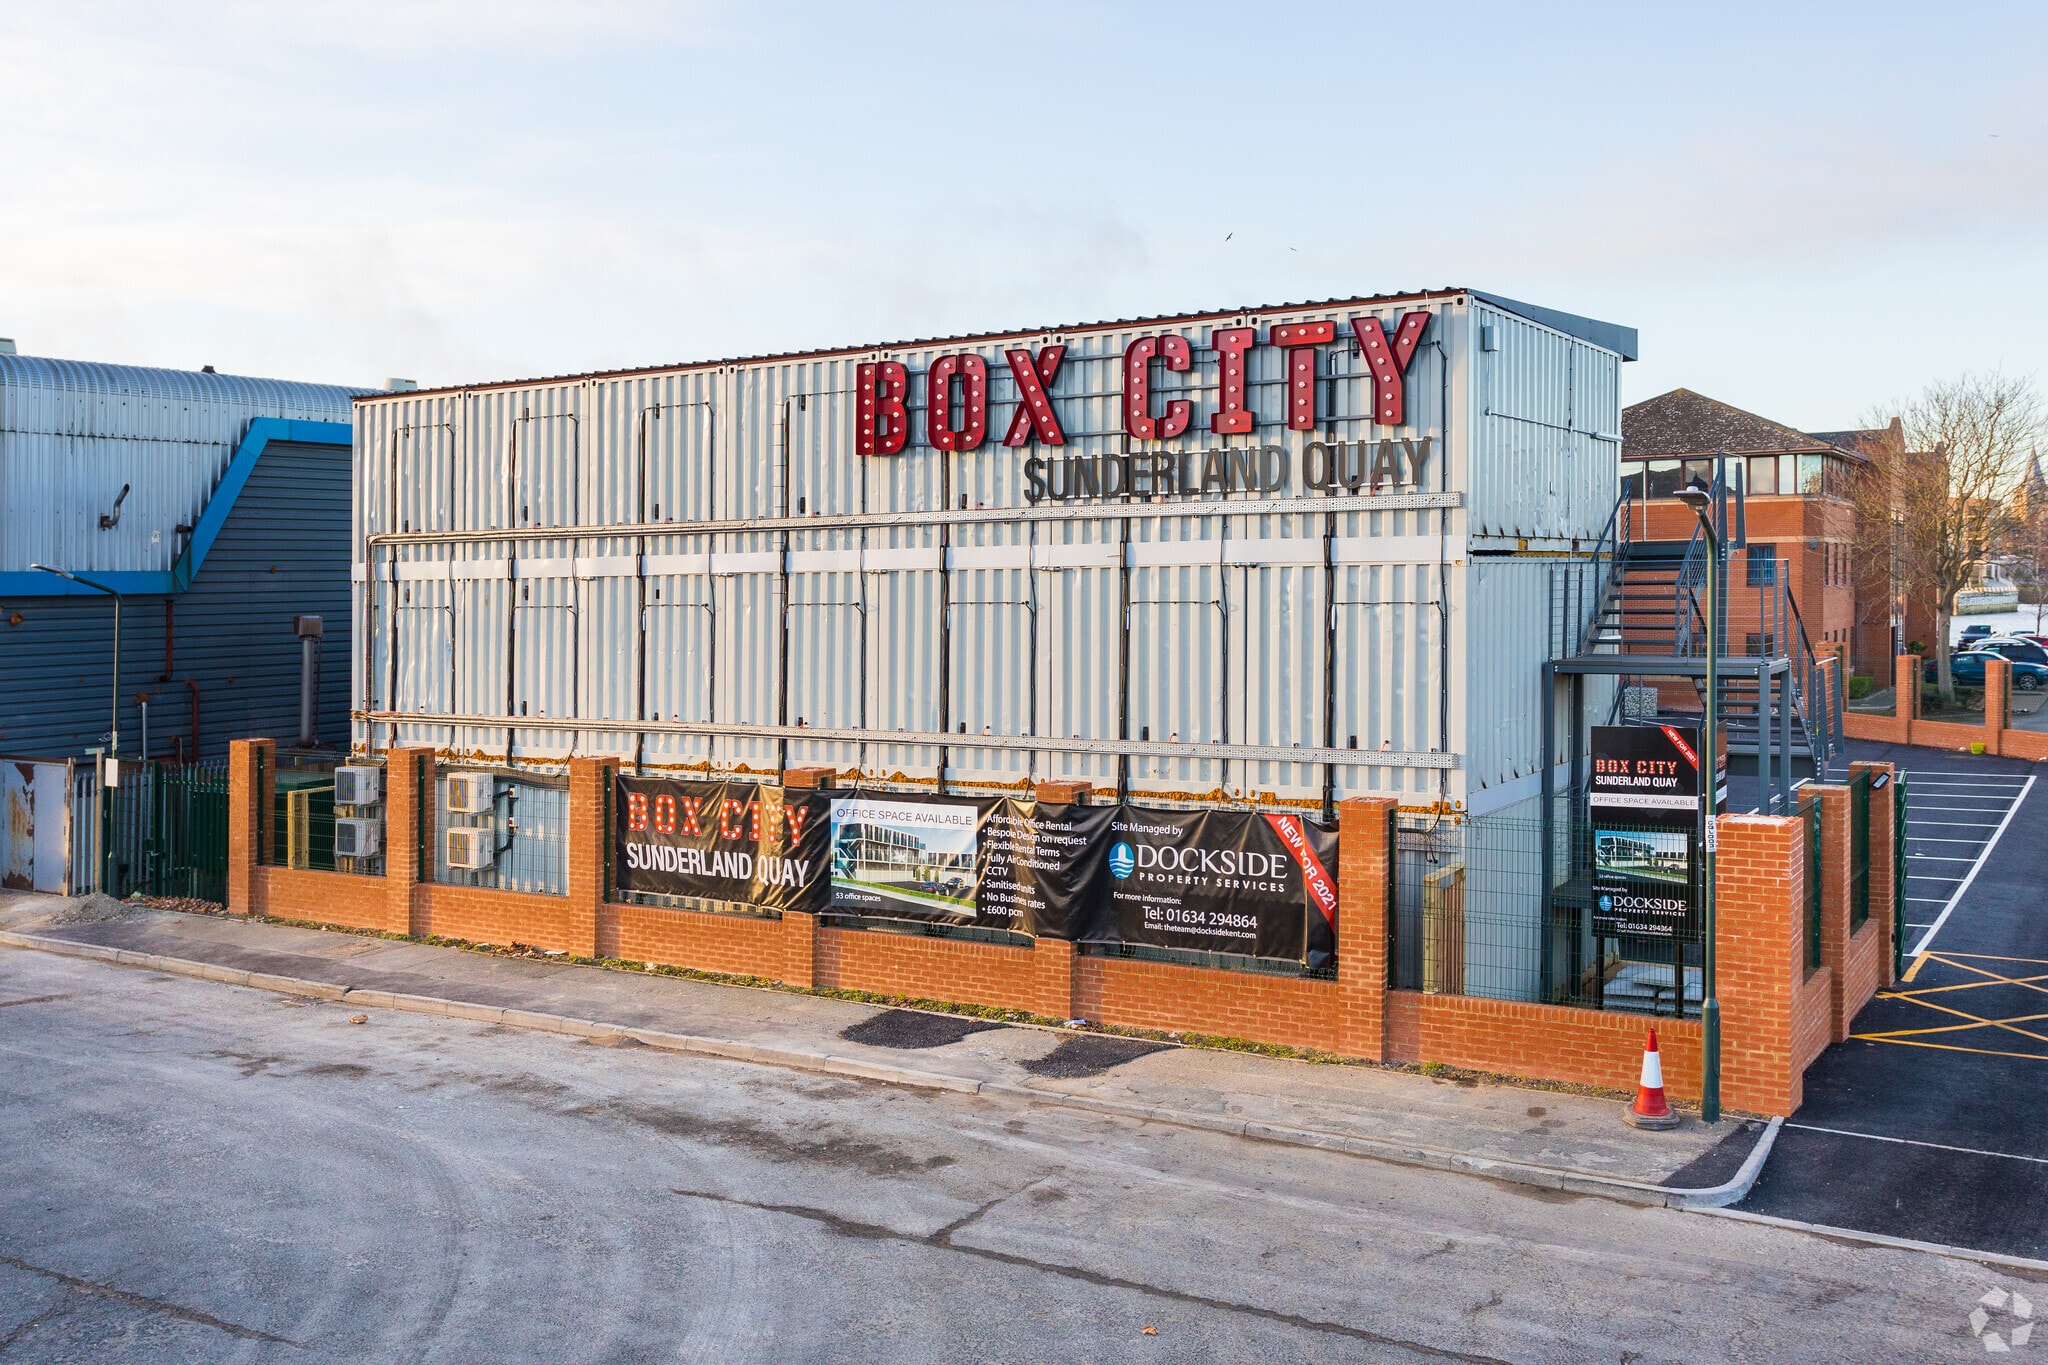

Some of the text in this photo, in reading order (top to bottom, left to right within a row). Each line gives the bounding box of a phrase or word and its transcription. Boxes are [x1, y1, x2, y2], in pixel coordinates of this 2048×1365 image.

[855, 310, 1433, 456] BOX CITY
[1023, 436, 1432, 502] SUNDERLAND QUAY
[1667, 729, 1697, 763] NEW FOR 2021
[1595, 759, 1678, 775] BOX CITY
[1595, 776, 1678, 787] SUNDERLAND QUAY
[1651, 798, 1696, 806] AVAILABLE
[627, 792, 808, 847] BOX CITY
[837, 808, 972, 825] OFFICE SPACE AVAILABLE
[1023, 818, 1045, 829] Office
[1045, 820, 1072, 831] Rental
[1111, 821, 1184, 837] Site Managed by
[1017, 831, 1040, 844] Design
[1041, 836, 1052, 844] on
[1054, 836, 1087, 847] request
[987, 840, 1060, 857] Flexible Rental Terms
[627, 842, 810, 888] SUNDERLAND QUAY
[987, 853, 1060, 870] Fully Air Conditioned
[1135, 844, 1288, 879] DOCKSIDE
[1277, 815, 1337, 911] NEW FOR 2021
[986, 866, 1008, 876] CCTV
[986, 880, 1035, 894] Sanitised units
[1139, 872, 1285, 892] PROPERTY SERVICES
[844, 892, 861, 900] office
[986, 892, 999, 901] No
[1027, 899, 1046, 909] rates
[1113, 891, 1124, 899] For
[1142, 894, 1182, 905] information:
[1613, 895, 1687, 911] DOCKSIDE
[987, 905, 1024, 917] £600 pcm
[1143, 906, 1258, 928] Tel: 01634 294864
[1144, 922, 1256, 939] Email: theteam@docksidekent.com
